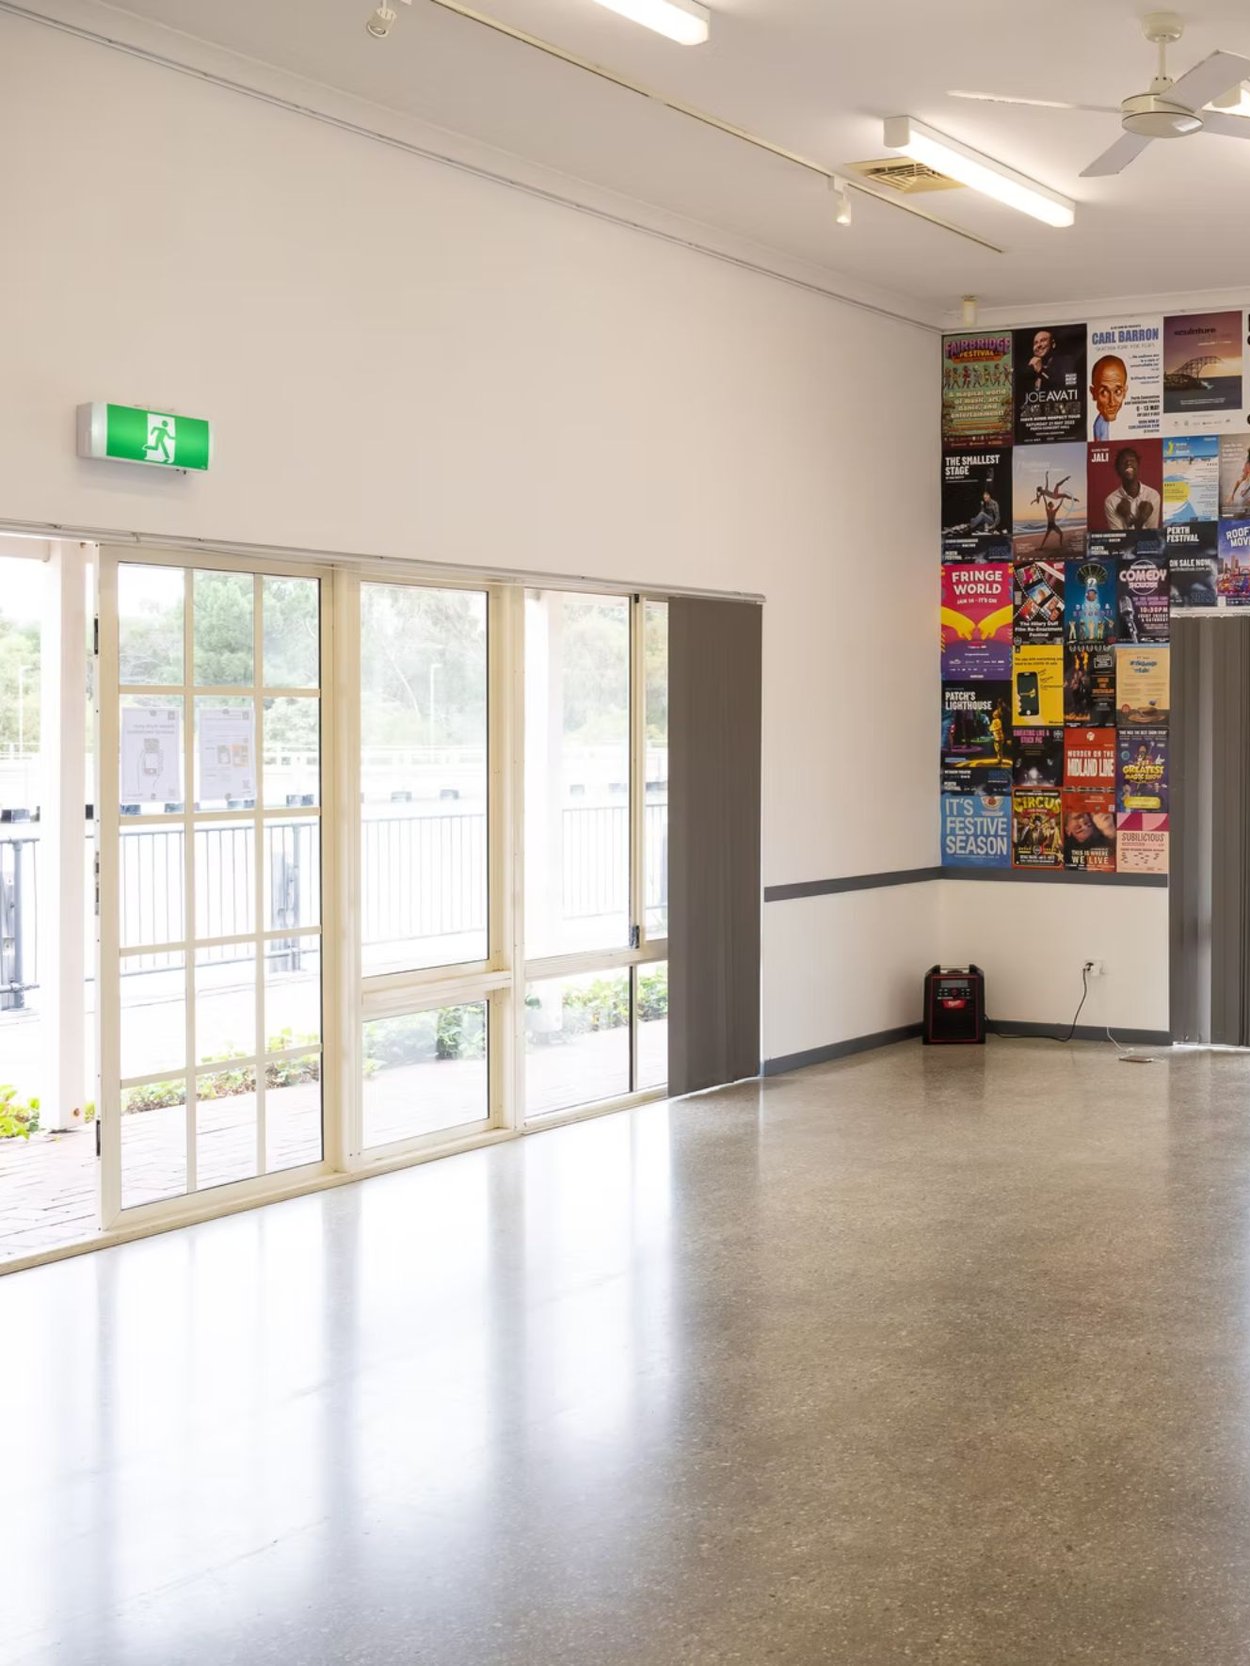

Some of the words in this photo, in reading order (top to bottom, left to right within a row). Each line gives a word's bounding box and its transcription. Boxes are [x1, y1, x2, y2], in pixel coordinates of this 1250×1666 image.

[1092, 332, 1116, 344] CARL
[1118, 328, 1159, 342] BARRON
[946, 337, 1010, 356] FAIRBRIDGE
[959, 350, 994, 358] FESTIVAL
[945, 457, 960, 465] THE
[962, 455, 1000, 464] SMALLEST
[1091, 453, 1109, 462] JALI
[945, 466, 969, 475] STAGE
[952, 571, 1002, 582] FRINGE
[1120, 570, 1167, 580] COMEDY
[954, 584, 1001, 594] WORLD
[945, 692, 975, 700] PATCH'S
[946, 701, 992, 709] LIGHTHOUSE
[1068, 759, 1096, 776] MIDLAND
[1099, 759, 1114, 776] LINE
[946, 799, 973, 815] IT'S
[1013, 797, 1061, 812] CIRCUS
[947, 818, 1007, 835] FESTIVE
[1122, 833, 1164, 841] SUBILICIOUS
[946, 836, 1007, 855] SEASON
